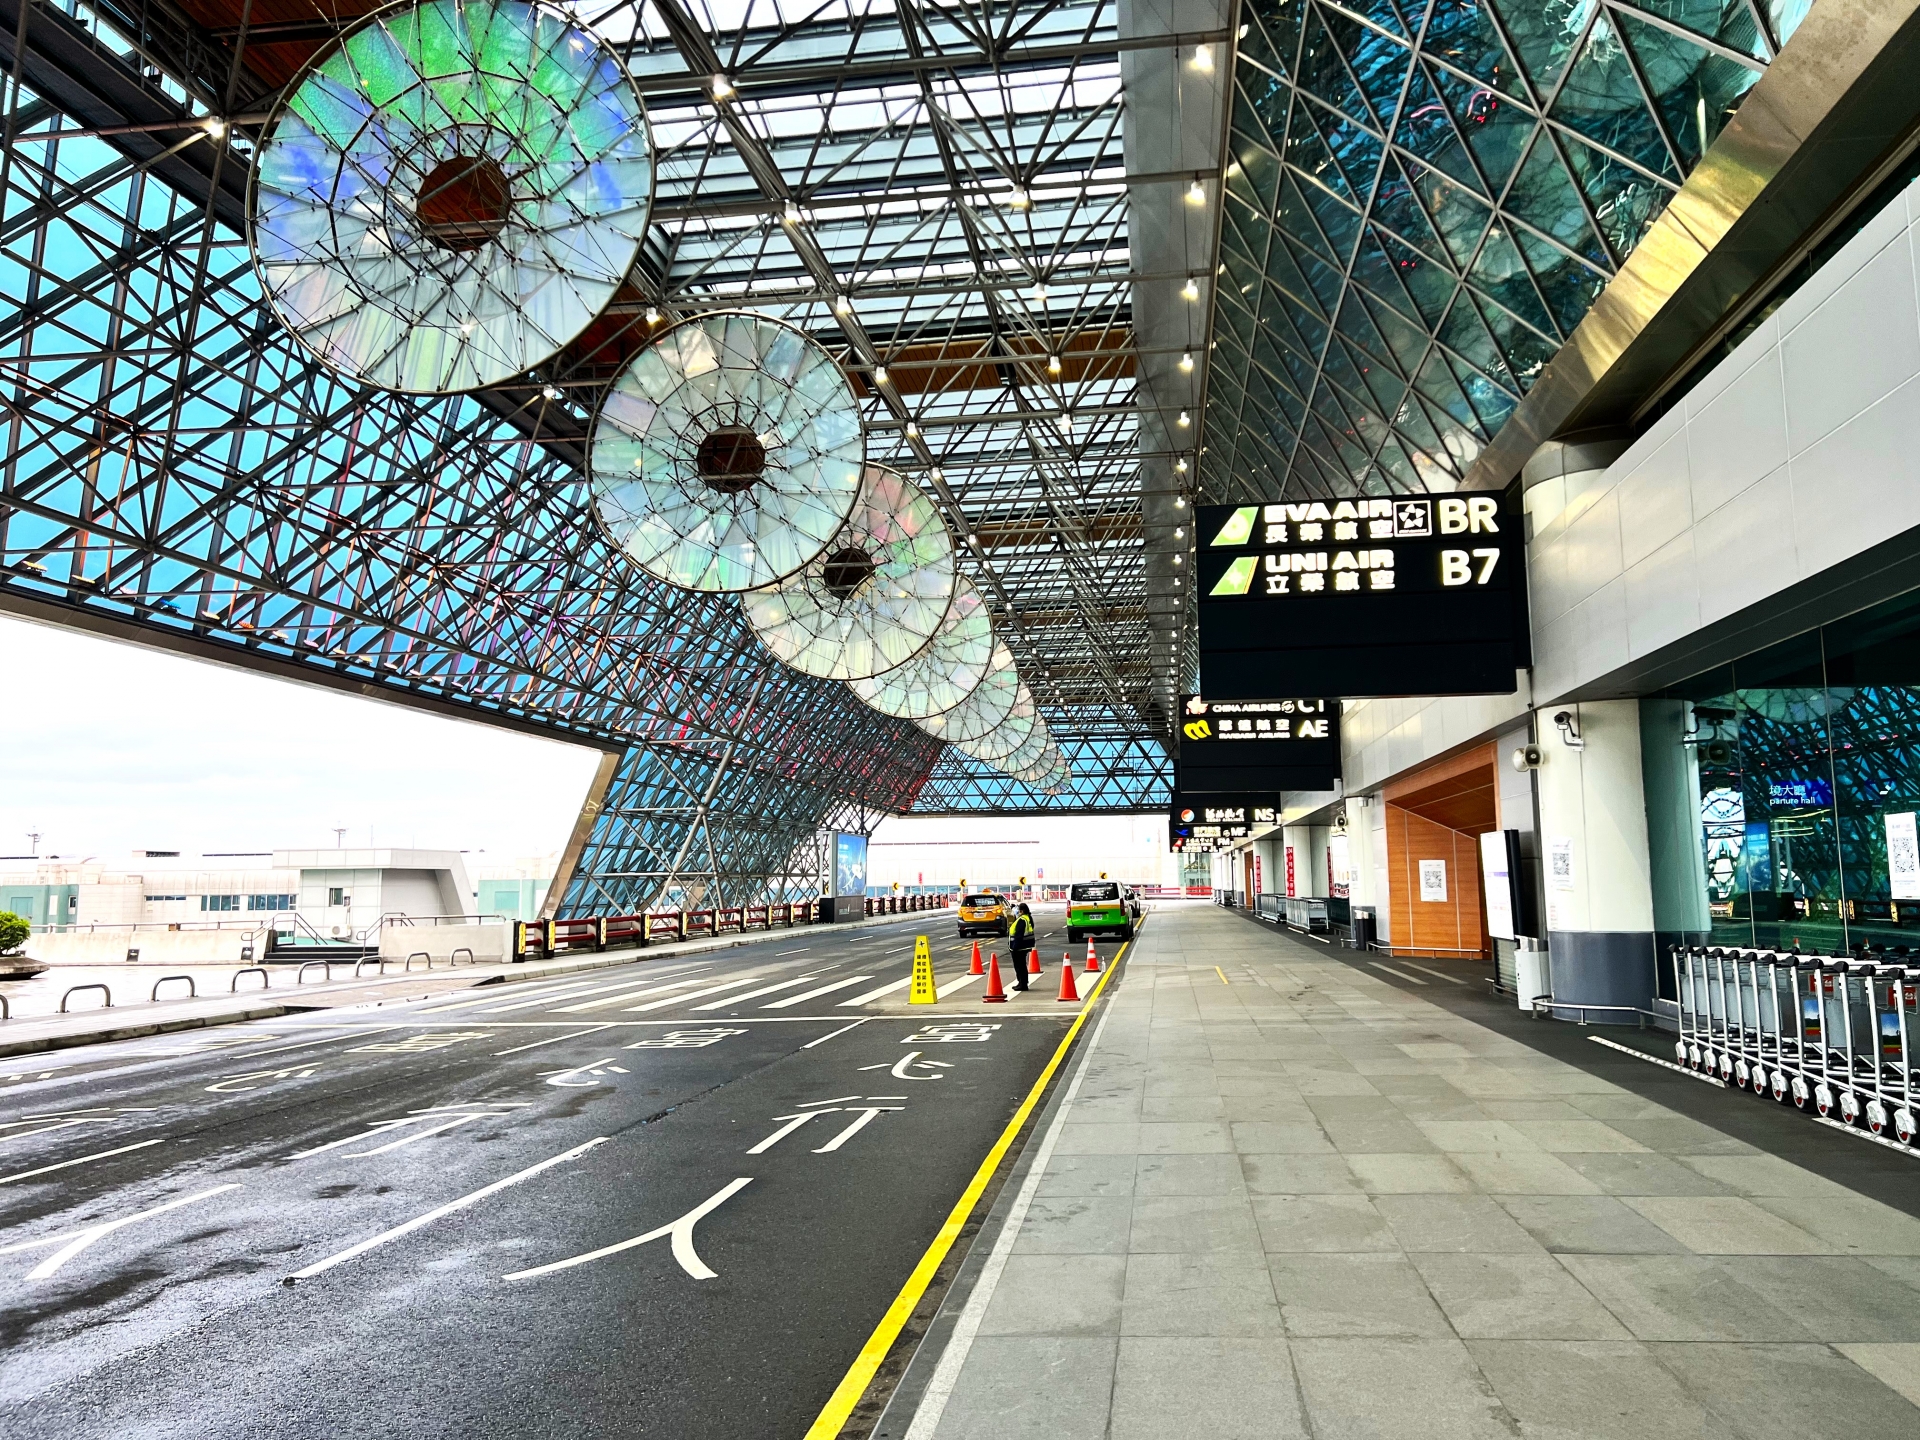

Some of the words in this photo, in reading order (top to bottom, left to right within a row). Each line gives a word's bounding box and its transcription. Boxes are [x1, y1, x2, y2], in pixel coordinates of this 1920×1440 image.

[1439, 497, 1500, 535] BR
[1265, 520, 1394, 544] 長榮航空
[1265, 552, 1328, 573] UNI
[1332, 549, 1395, 571] AIR
[1441, 548, 1500, 586] B7
[1265, 570, 1395, 594] 立榮航空
[1213, 704, 1240, 713] CHINA
[1242, 703, 1281, 713] AIRLINES
[1298, 720, 1328, 738] AE
[1255, 808, 1275, 821] NS
[1231, 827, 1246, 836] MF
